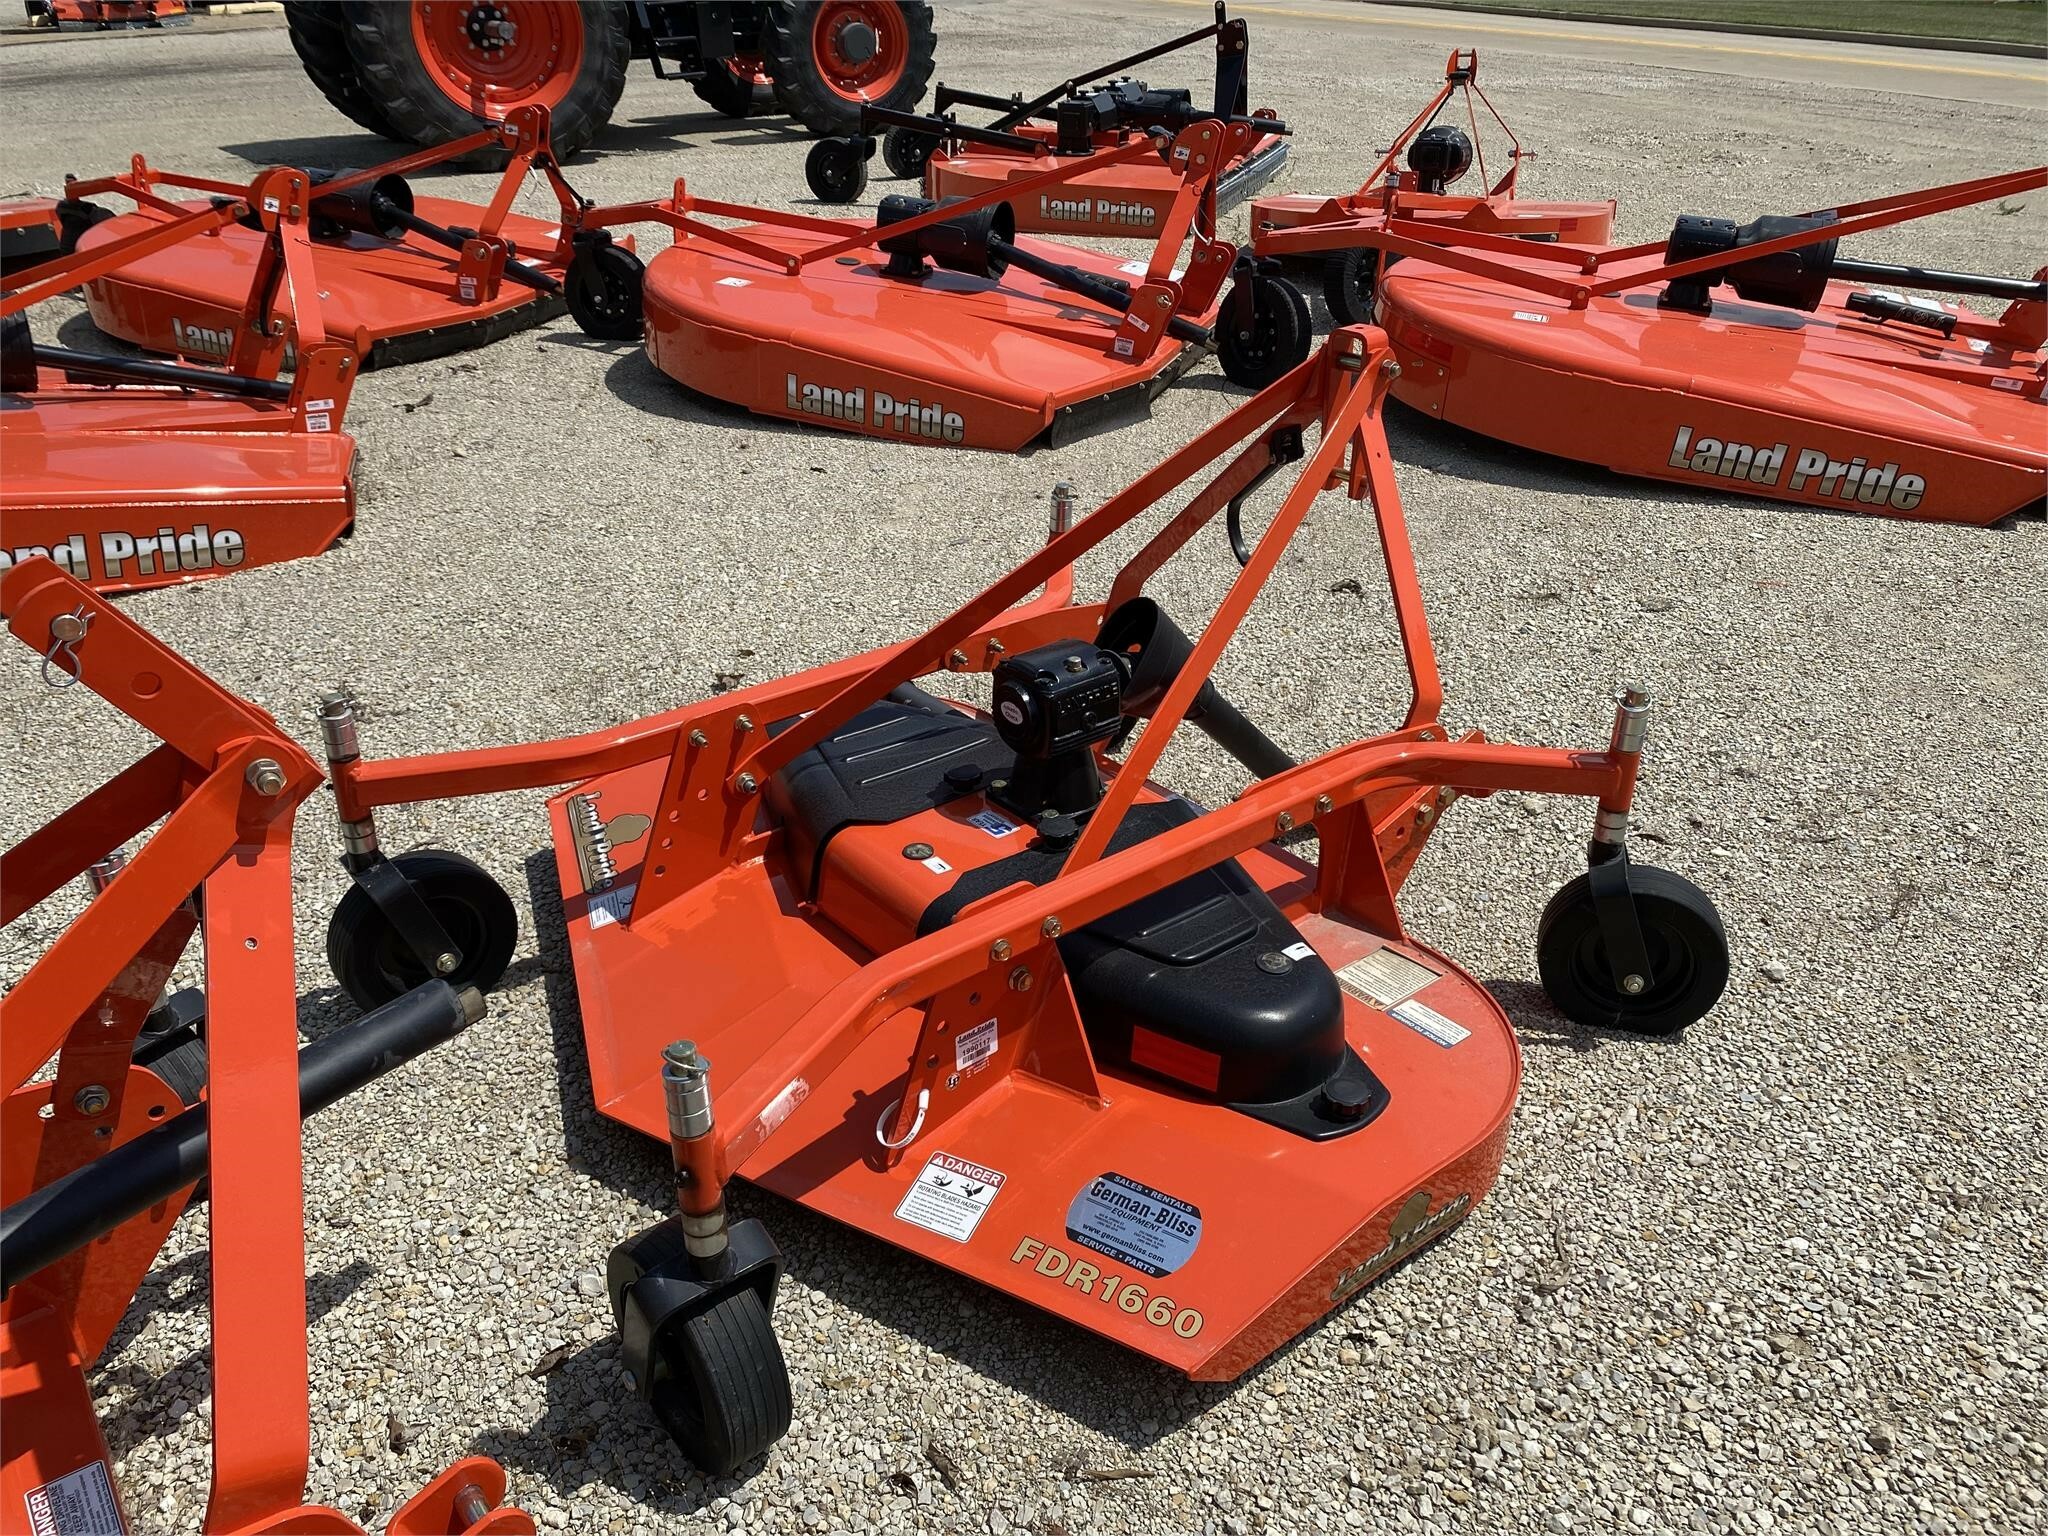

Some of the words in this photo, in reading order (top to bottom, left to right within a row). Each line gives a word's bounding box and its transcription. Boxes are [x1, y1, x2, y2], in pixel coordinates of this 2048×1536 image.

[1040, 195, 1091, 221] Land
[1097, 199, 1155, 226] Pride
[787, 373, 865, 424] Land
[873, 391, 964, 443] Pride
[1667, 425, 1789, 486] Land
[1788, 448, 1926, 510] Pride
[100, 524, 245, 578] Pride
[577, 791, 608, 835] Land
[587, 839, 619, 892] Pride
[962, 1037, 991, 1056] 1990117
[1422, 1030, 1449, 1046] NOTICE
[943, 1157, 1002, 1187] DANGER
[917, 1184, 941, 1198] ROTATING
[940, 1191, 961, 1205] BLADES
[961, 1199, 981, 1212] HAZARD
[1090, 1181, 1197, 1237] German-Bliss
[1113, 1175, 1143, 1192] SALES
[1150, 1190, 1193, 1213] RENTALS
[1111, 1208, 1162, 1233] EQUIPMENT
[1077, 1235, 1118, 1258] SERVICE
[1124, 1256, 1156, 1274] PARTS
[1082, 1223, 1165, 1264] www.germanbliss.com
[1010, 1236, 1204, 1339] FDR1660
[30, 1490, 57, 1536] ANGER
[72, 1515, 84, 1533] KEEP
